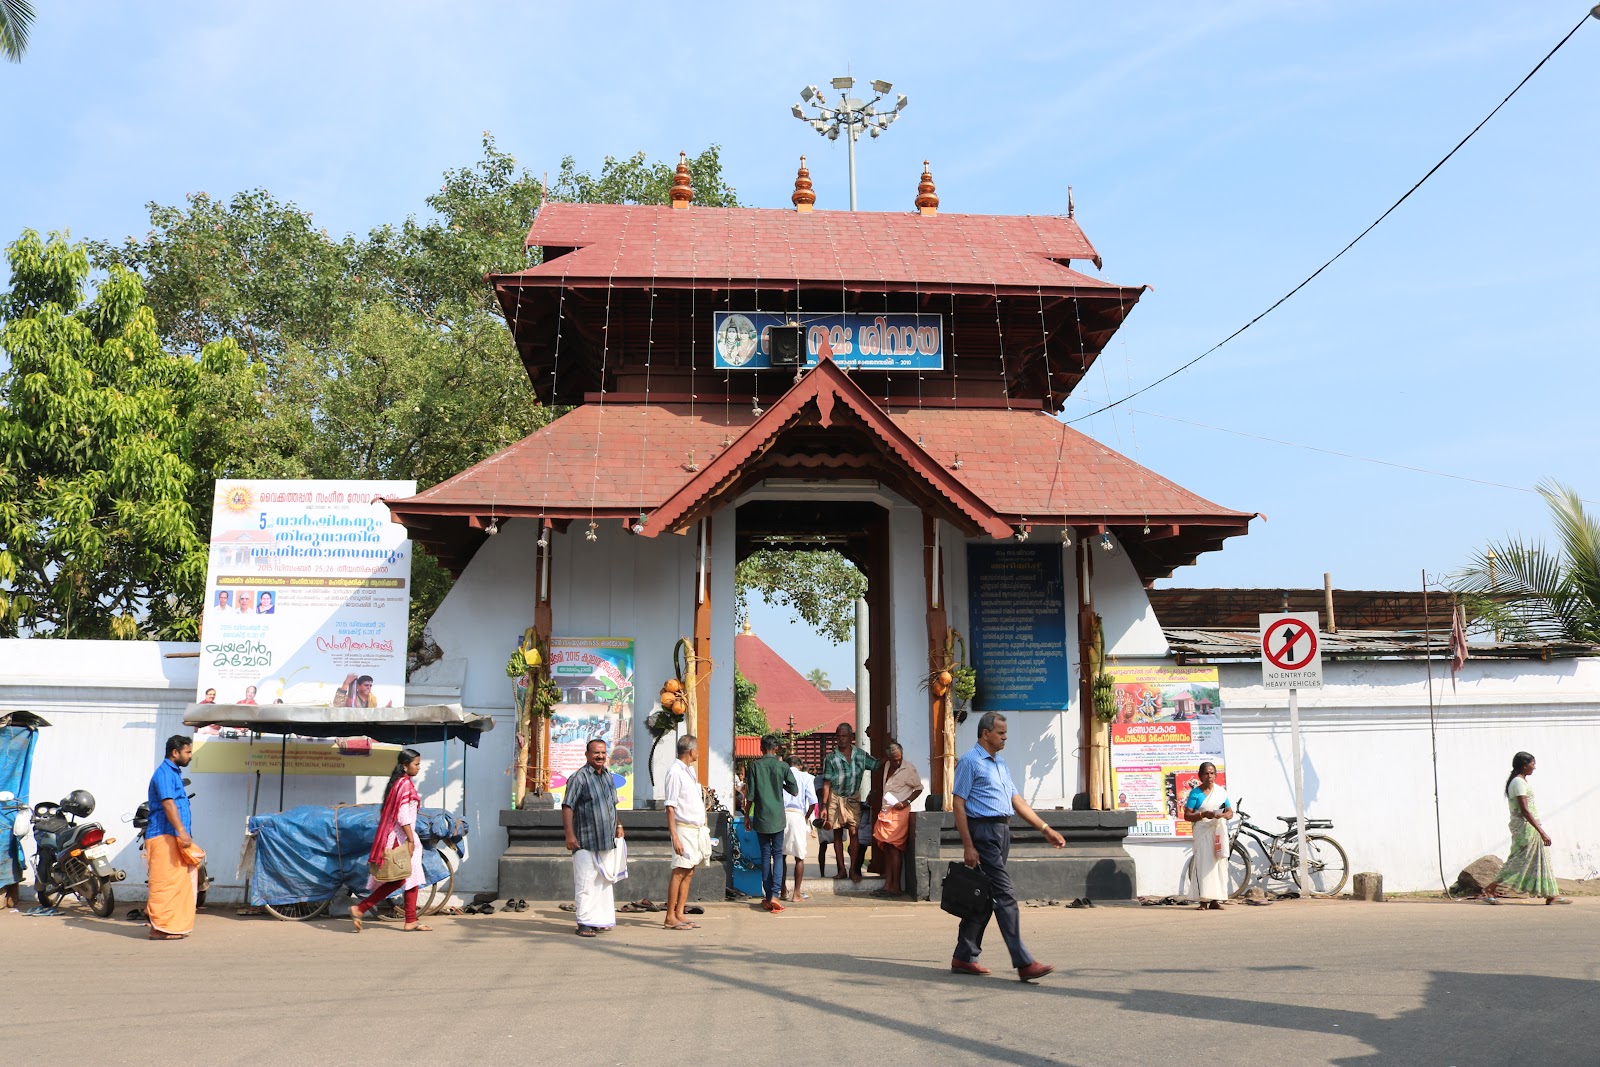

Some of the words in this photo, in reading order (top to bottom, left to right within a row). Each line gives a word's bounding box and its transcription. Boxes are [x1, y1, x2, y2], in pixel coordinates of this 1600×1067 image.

[859, 316, 939, 355] ശിവായ
[275, 530, 380, 548] തിരുവാതിര
[257, 564, 273, 572] 2015
[205, 639, 267, 655] വയലിൻ
[566, 651, 580, 661] 2015
[1126, 725, 1177, 735] മണ്ഡലകാല
